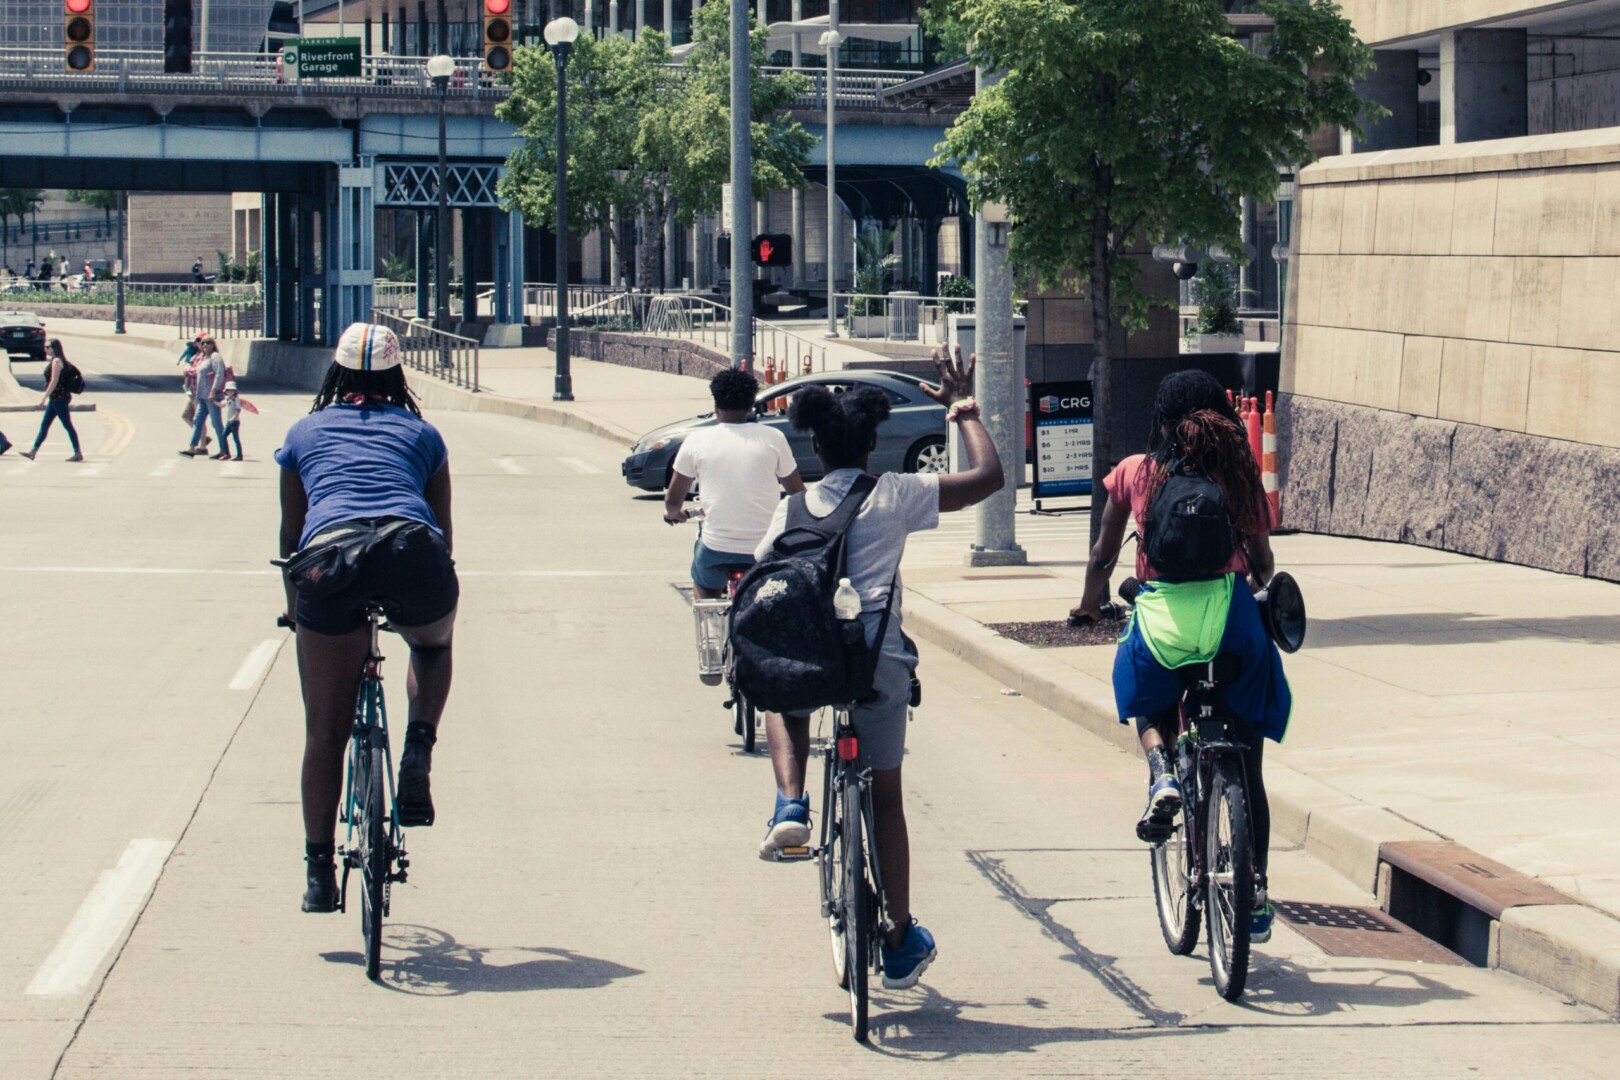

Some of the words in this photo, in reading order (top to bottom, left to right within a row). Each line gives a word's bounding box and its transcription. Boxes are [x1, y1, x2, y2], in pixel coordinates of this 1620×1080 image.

[301, 52, 354, 61] Riverfront
[301, 63, 338, 72] Garage
[195, 211, 220, 219] AND
[1060, 397, 1090, 409] CRG
